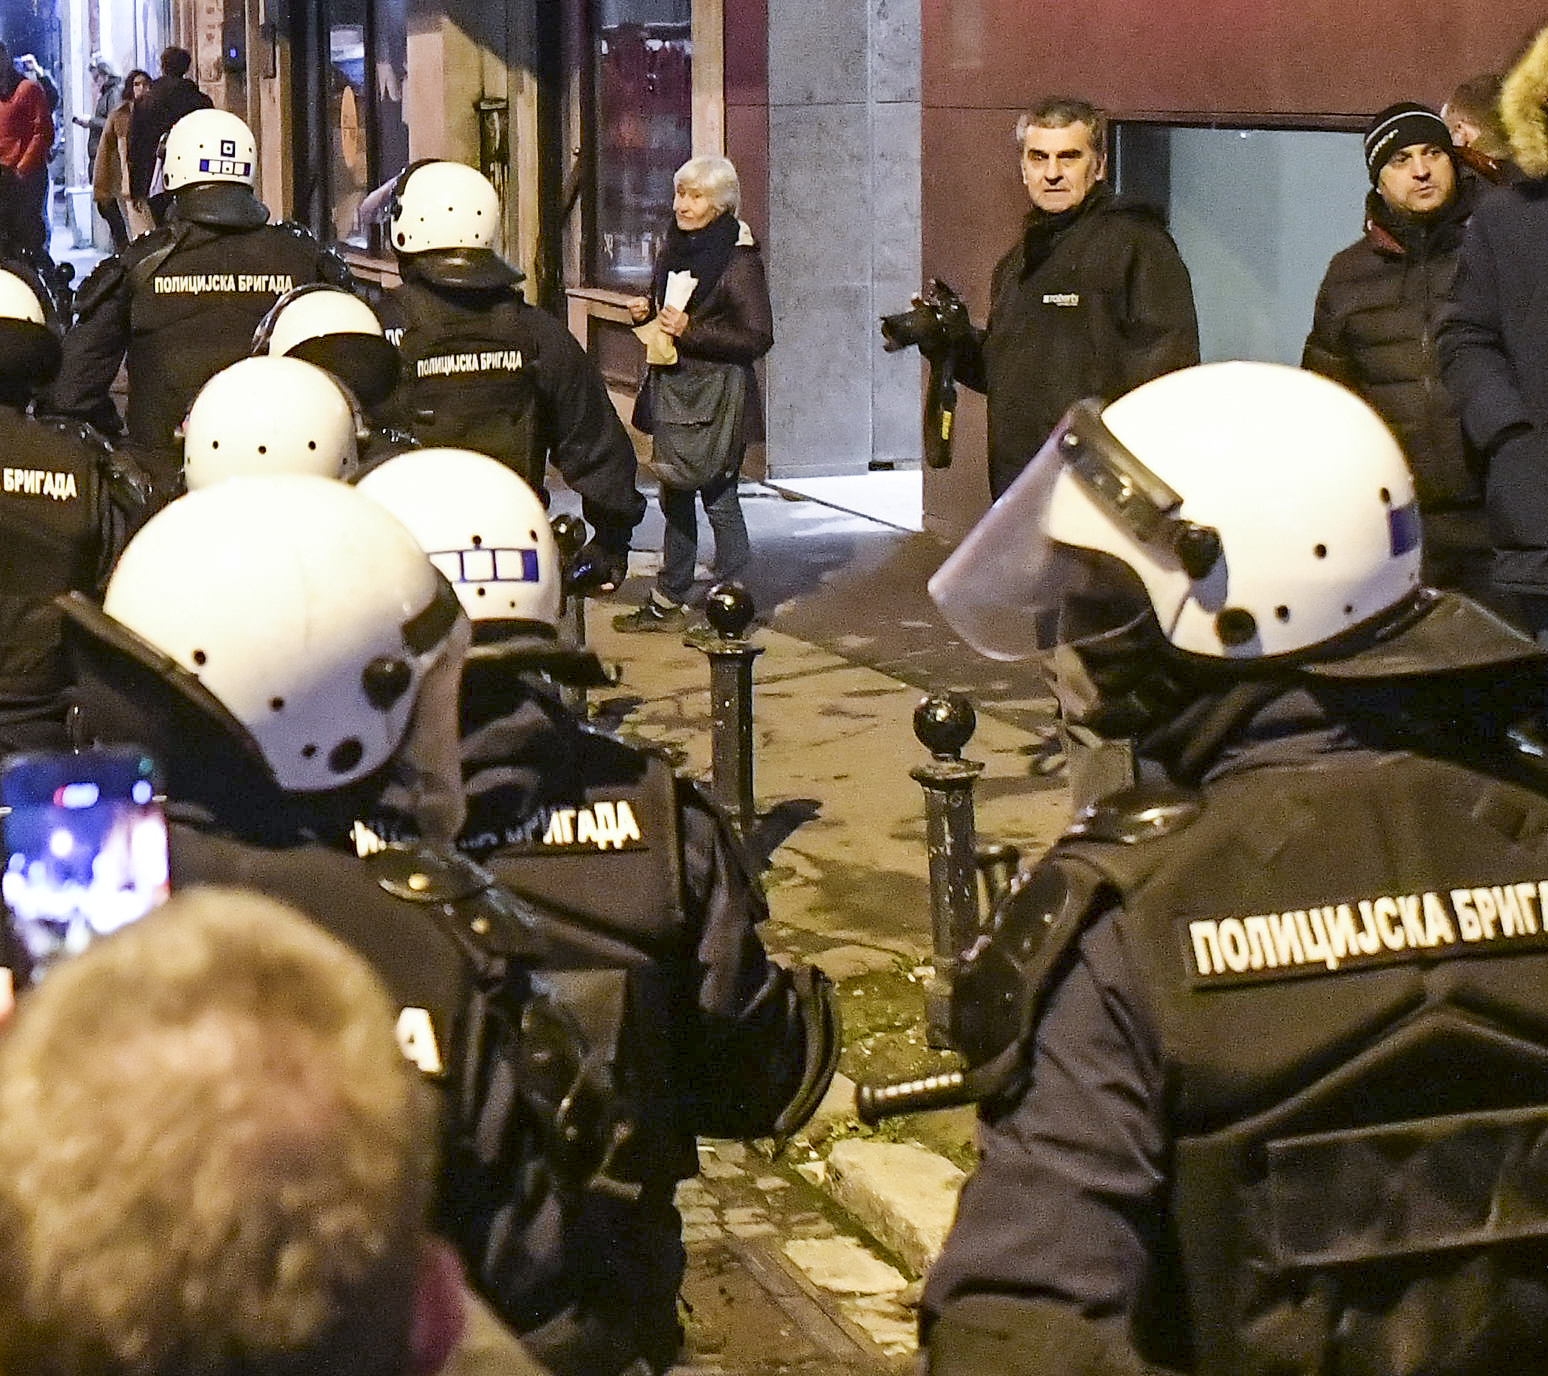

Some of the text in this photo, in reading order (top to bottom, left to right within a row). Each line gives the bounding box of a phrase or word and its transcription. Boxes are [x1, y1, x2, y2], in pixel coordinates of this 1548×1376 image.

[154, 274, 293, 295] ПОЛИЦИЈСКА БРИГАДА
[417, 350, 523, 378] ПОЛИЦИЈСКА БРИГАДА
[3, 468, 78, 501] БРИГАДА
[1190, 896, 1452, 976] ПОЛИЦИЈСКА
